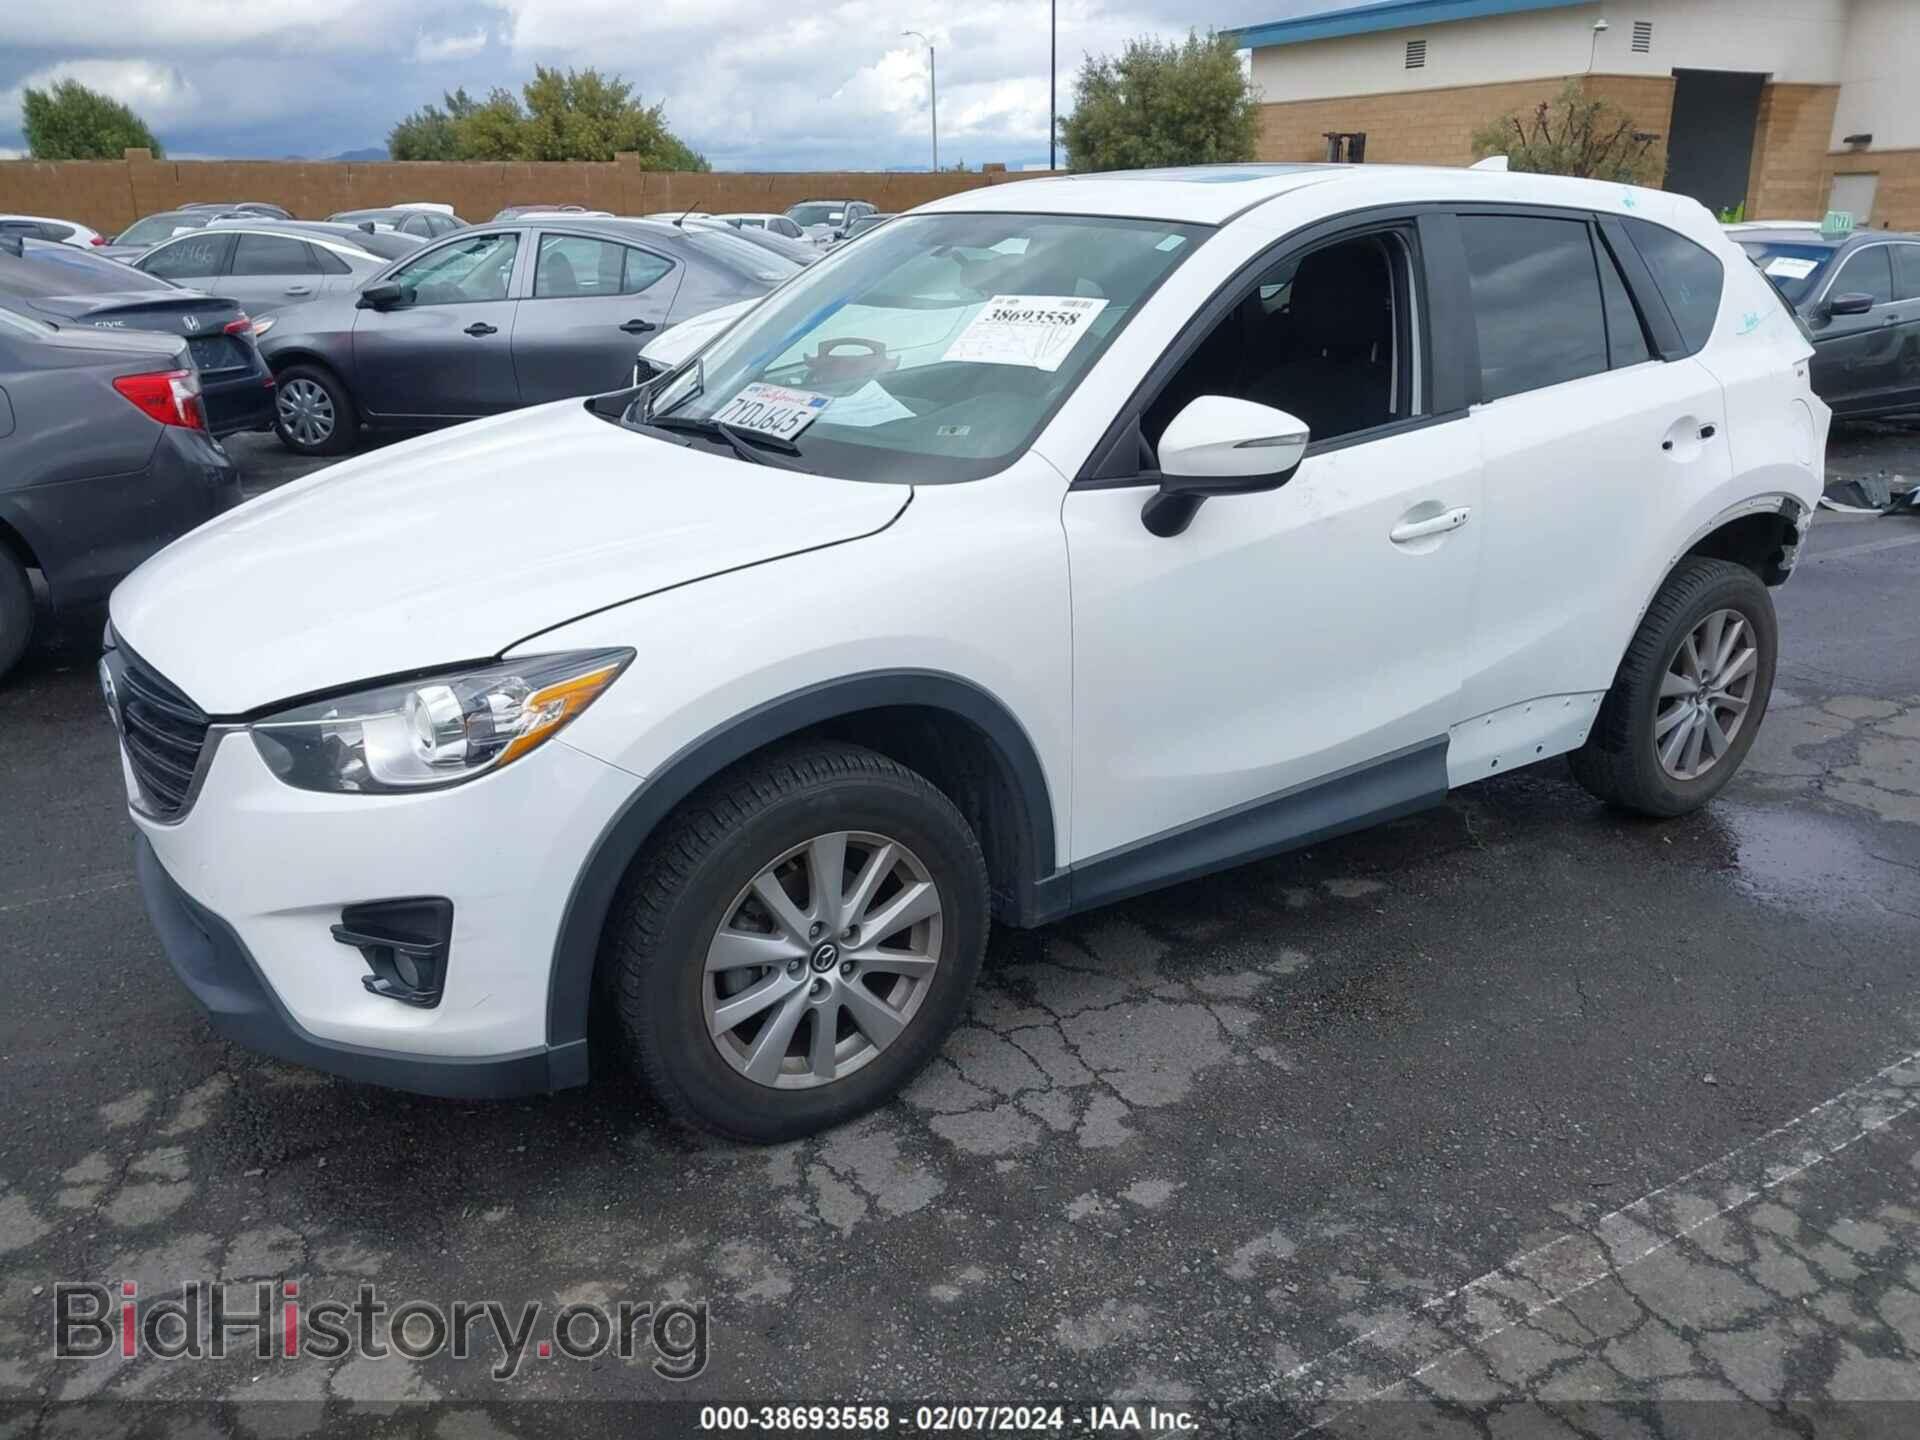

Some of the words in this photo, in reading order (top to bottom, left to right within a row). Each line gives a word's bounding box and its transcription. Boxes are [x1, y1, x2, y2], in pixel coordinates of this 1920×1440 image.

[95, 320, 127, 328] CIVIC
[985, 308, 1081, 326] 38693558
[719, 397, 808, 434] 7YDJ645
